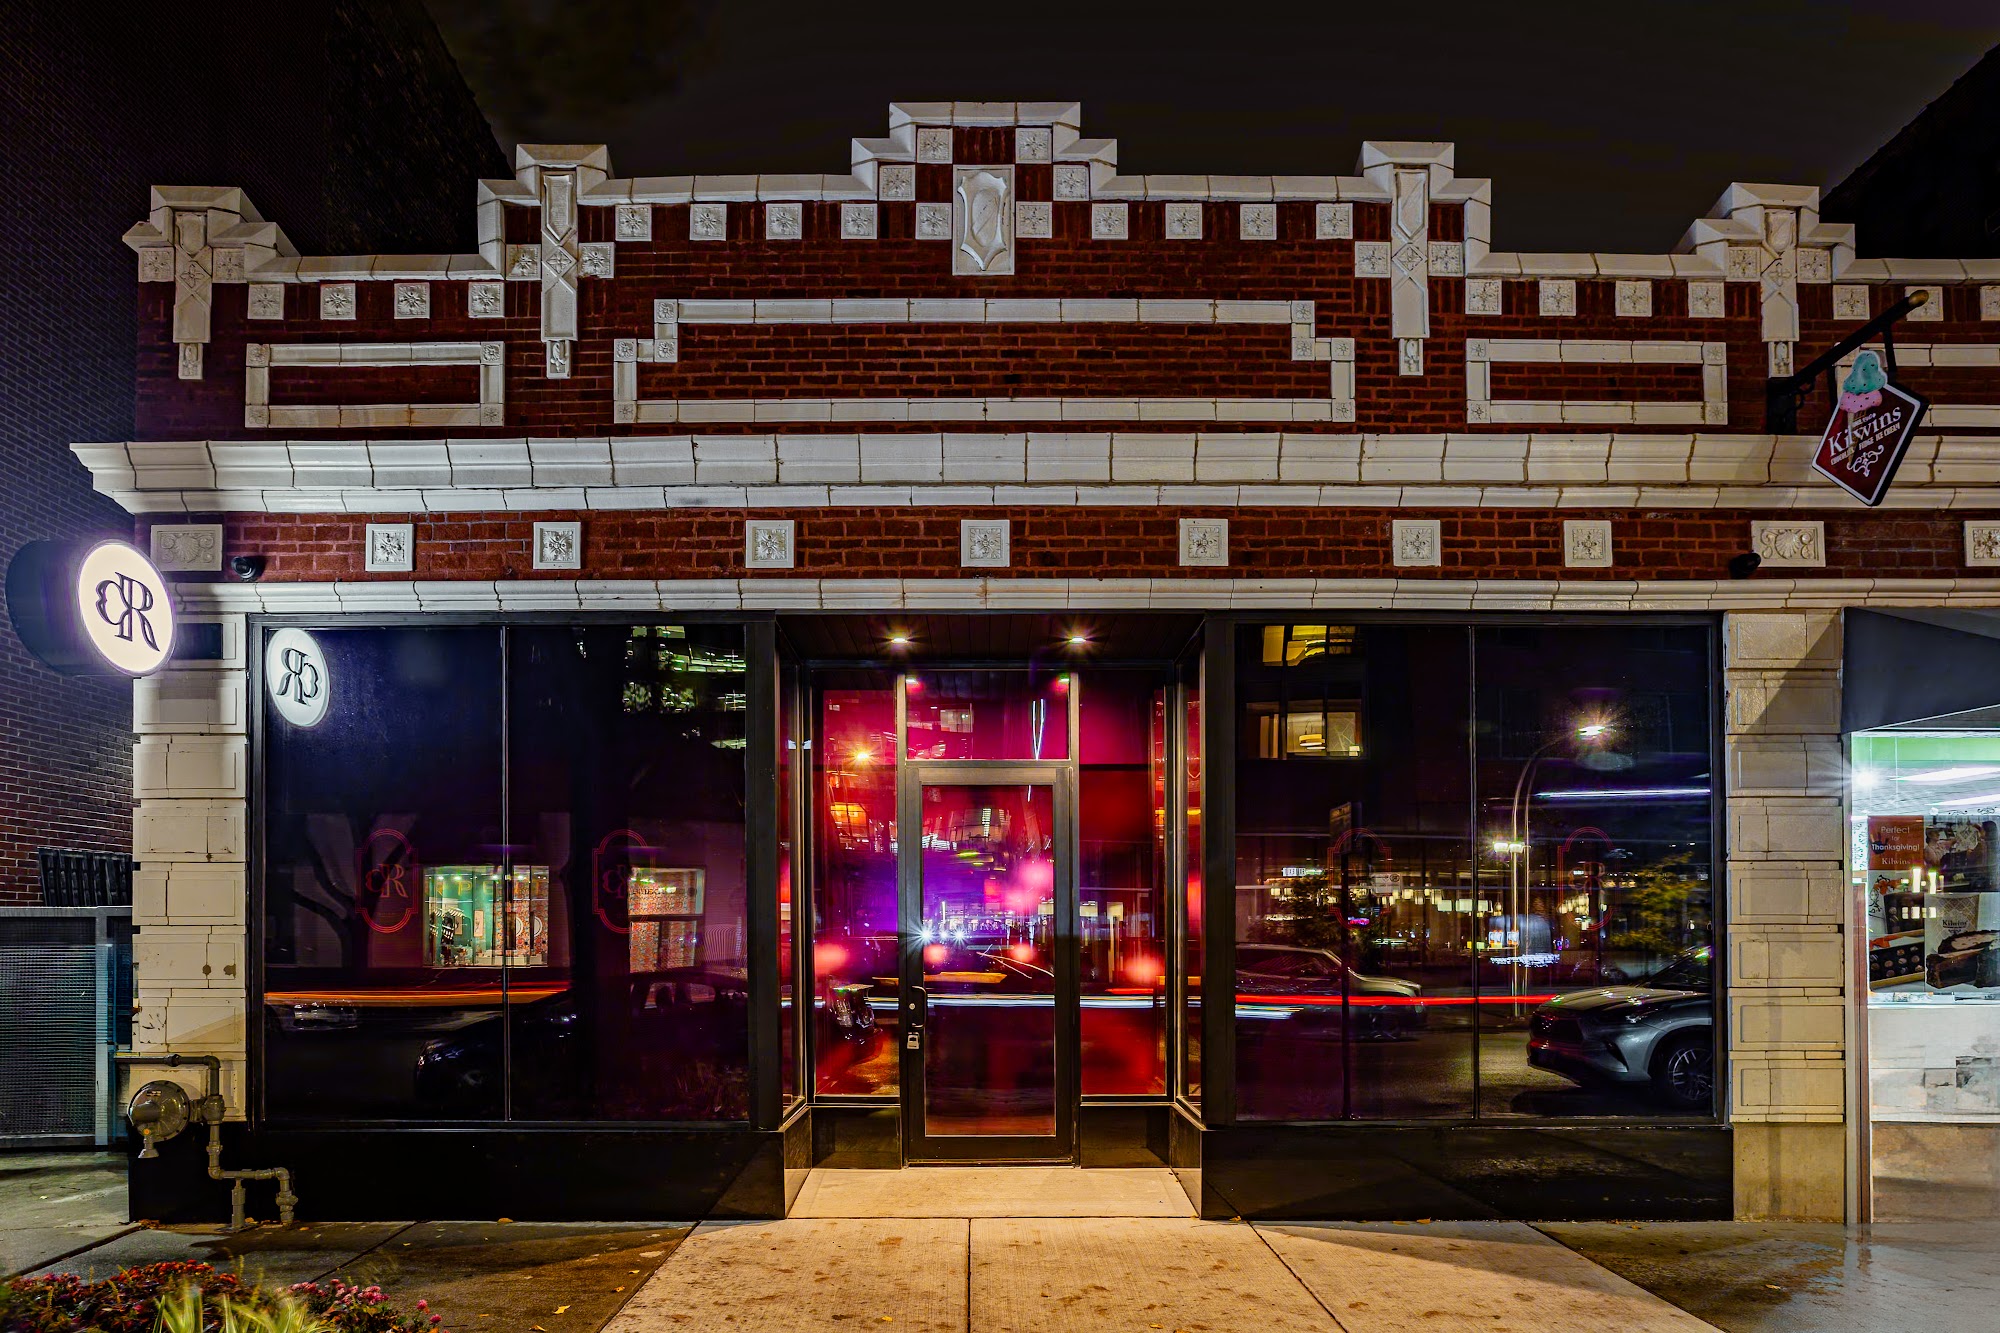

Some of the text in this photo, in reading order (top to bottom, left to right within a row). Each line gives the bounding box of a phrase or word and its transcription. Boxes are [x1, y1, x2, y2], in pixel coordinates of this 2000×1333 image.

[1828, 407, 1901, 457] Kilwins
[1881, 826, 1910, 834] Perfect
[1872, 844, 1920, 852] Thanksgiving!
[1882, 858, 1911, 866] Kilwins
